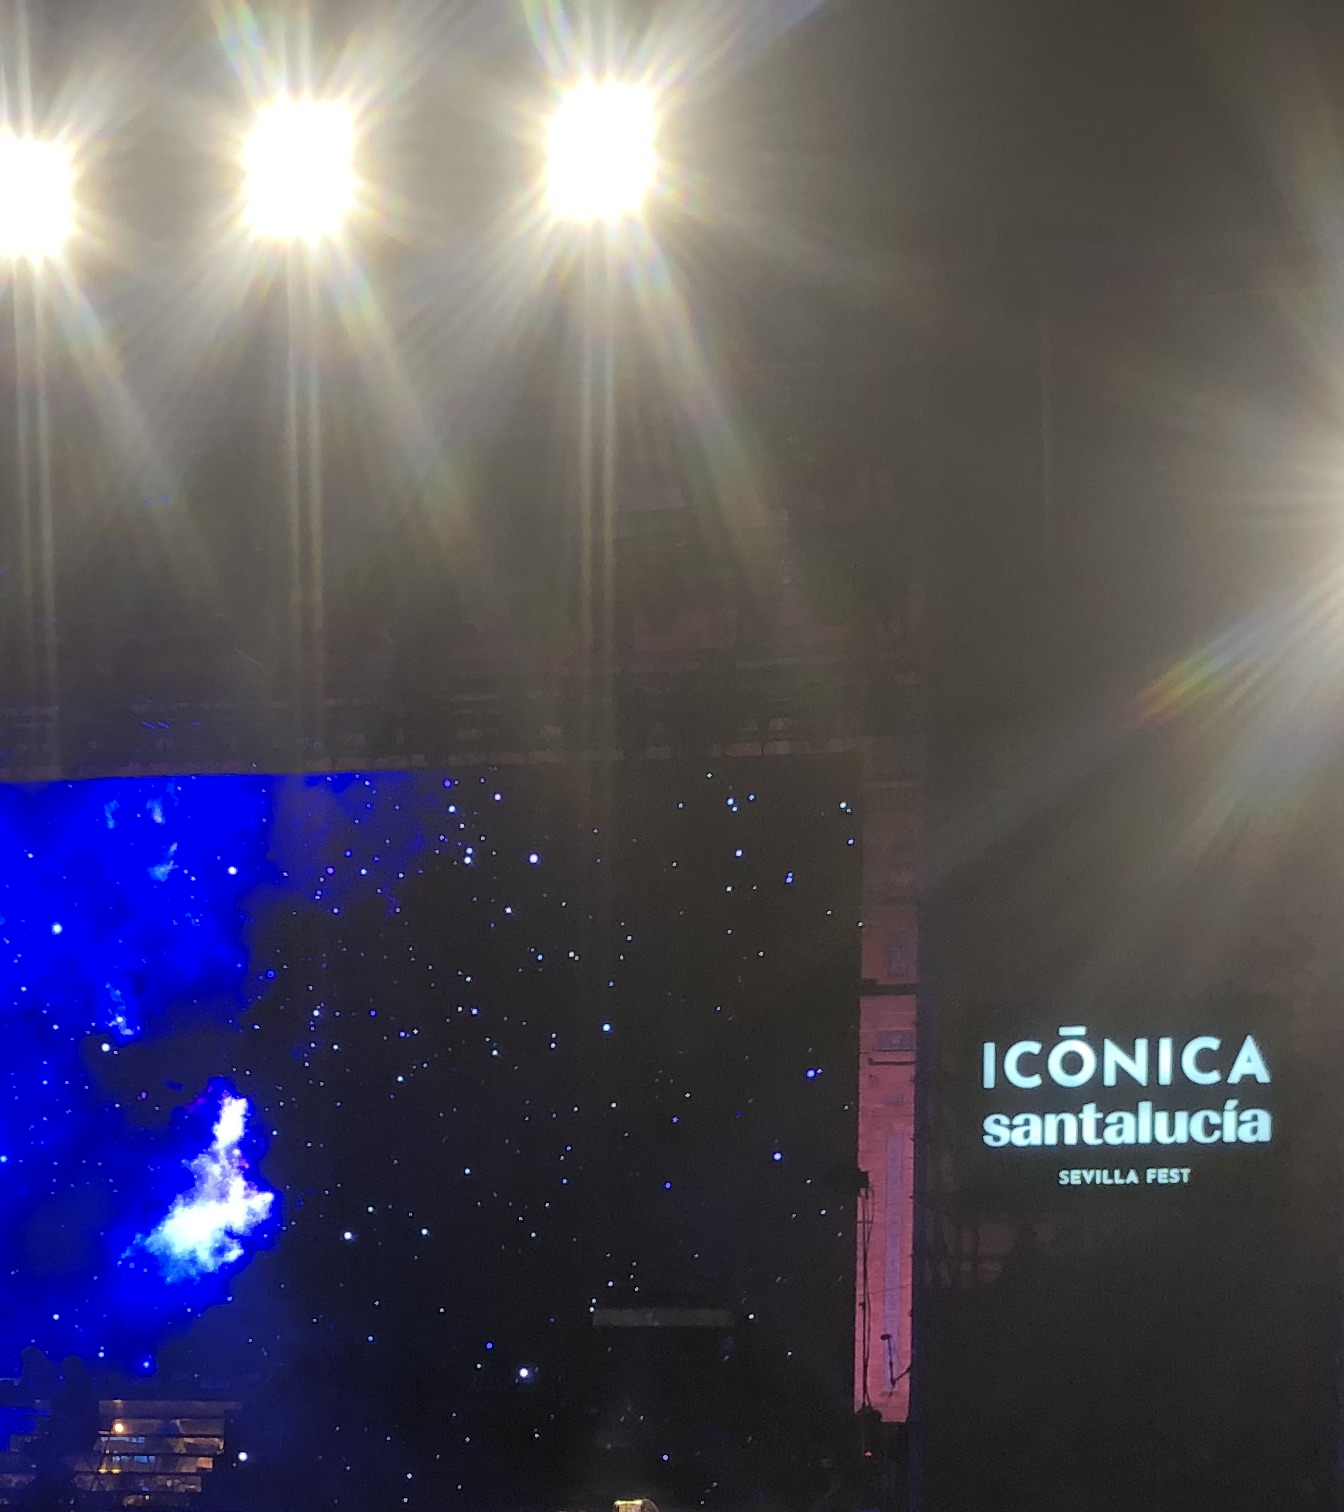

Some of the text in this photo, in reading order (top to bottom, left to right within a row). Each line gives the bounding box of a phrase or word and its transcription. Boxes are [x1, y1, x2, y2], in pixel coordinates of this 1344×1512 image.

[982, 1098, 1273, 1148] santalucía
[1058, 1167, 1192, 1185] SEVILLA FEST
